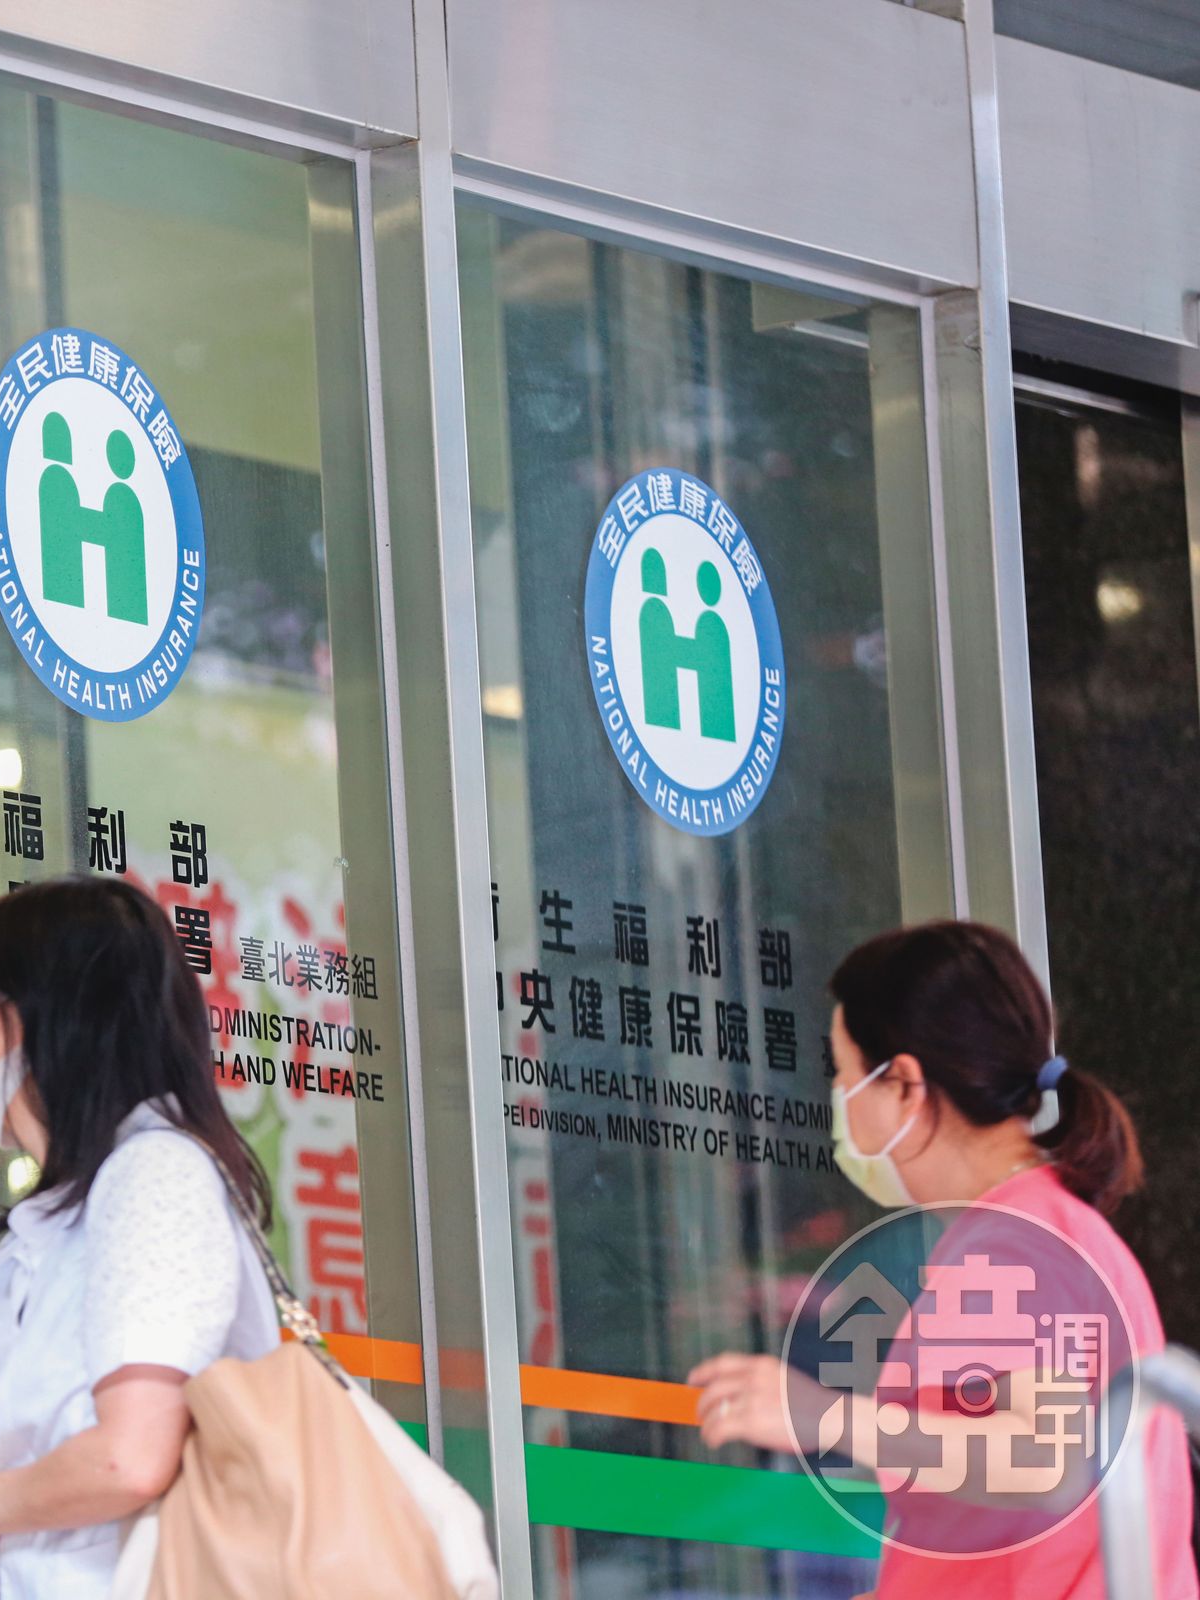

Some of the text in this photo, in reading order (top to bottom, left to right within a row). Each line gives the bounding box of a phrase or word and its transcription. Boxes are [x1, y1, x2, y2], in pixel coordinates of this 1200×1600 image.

[598, 472, 763, 596] 全民健康保險
[53, 658, 131, 711] HEALTH
[136, 549, 200, 703] INSURANCE
[591, 635, 781, 826] NATIONAL HEALTH INSURANCE
[240, 936, 378, 1000] 臺北業務組
[209, 1005, 380, 1056] DMINISTRATION-
[496, 968, 797, 1072] 央健康保險署
[231, 1053, 276, 1085] AND
[282, 1058, 384, 1102] WELFARE
[502, 1055, 833, 1132] TIONAL HEALTH INSURANCE ADMI
[530, 1107, 601, 1143] DIVISION,
[607, 1113, 698, 1152] MINISTRY
[704, 1128, 729, 1157] OF
[736, 1133, 810, 1169] HEALTH
